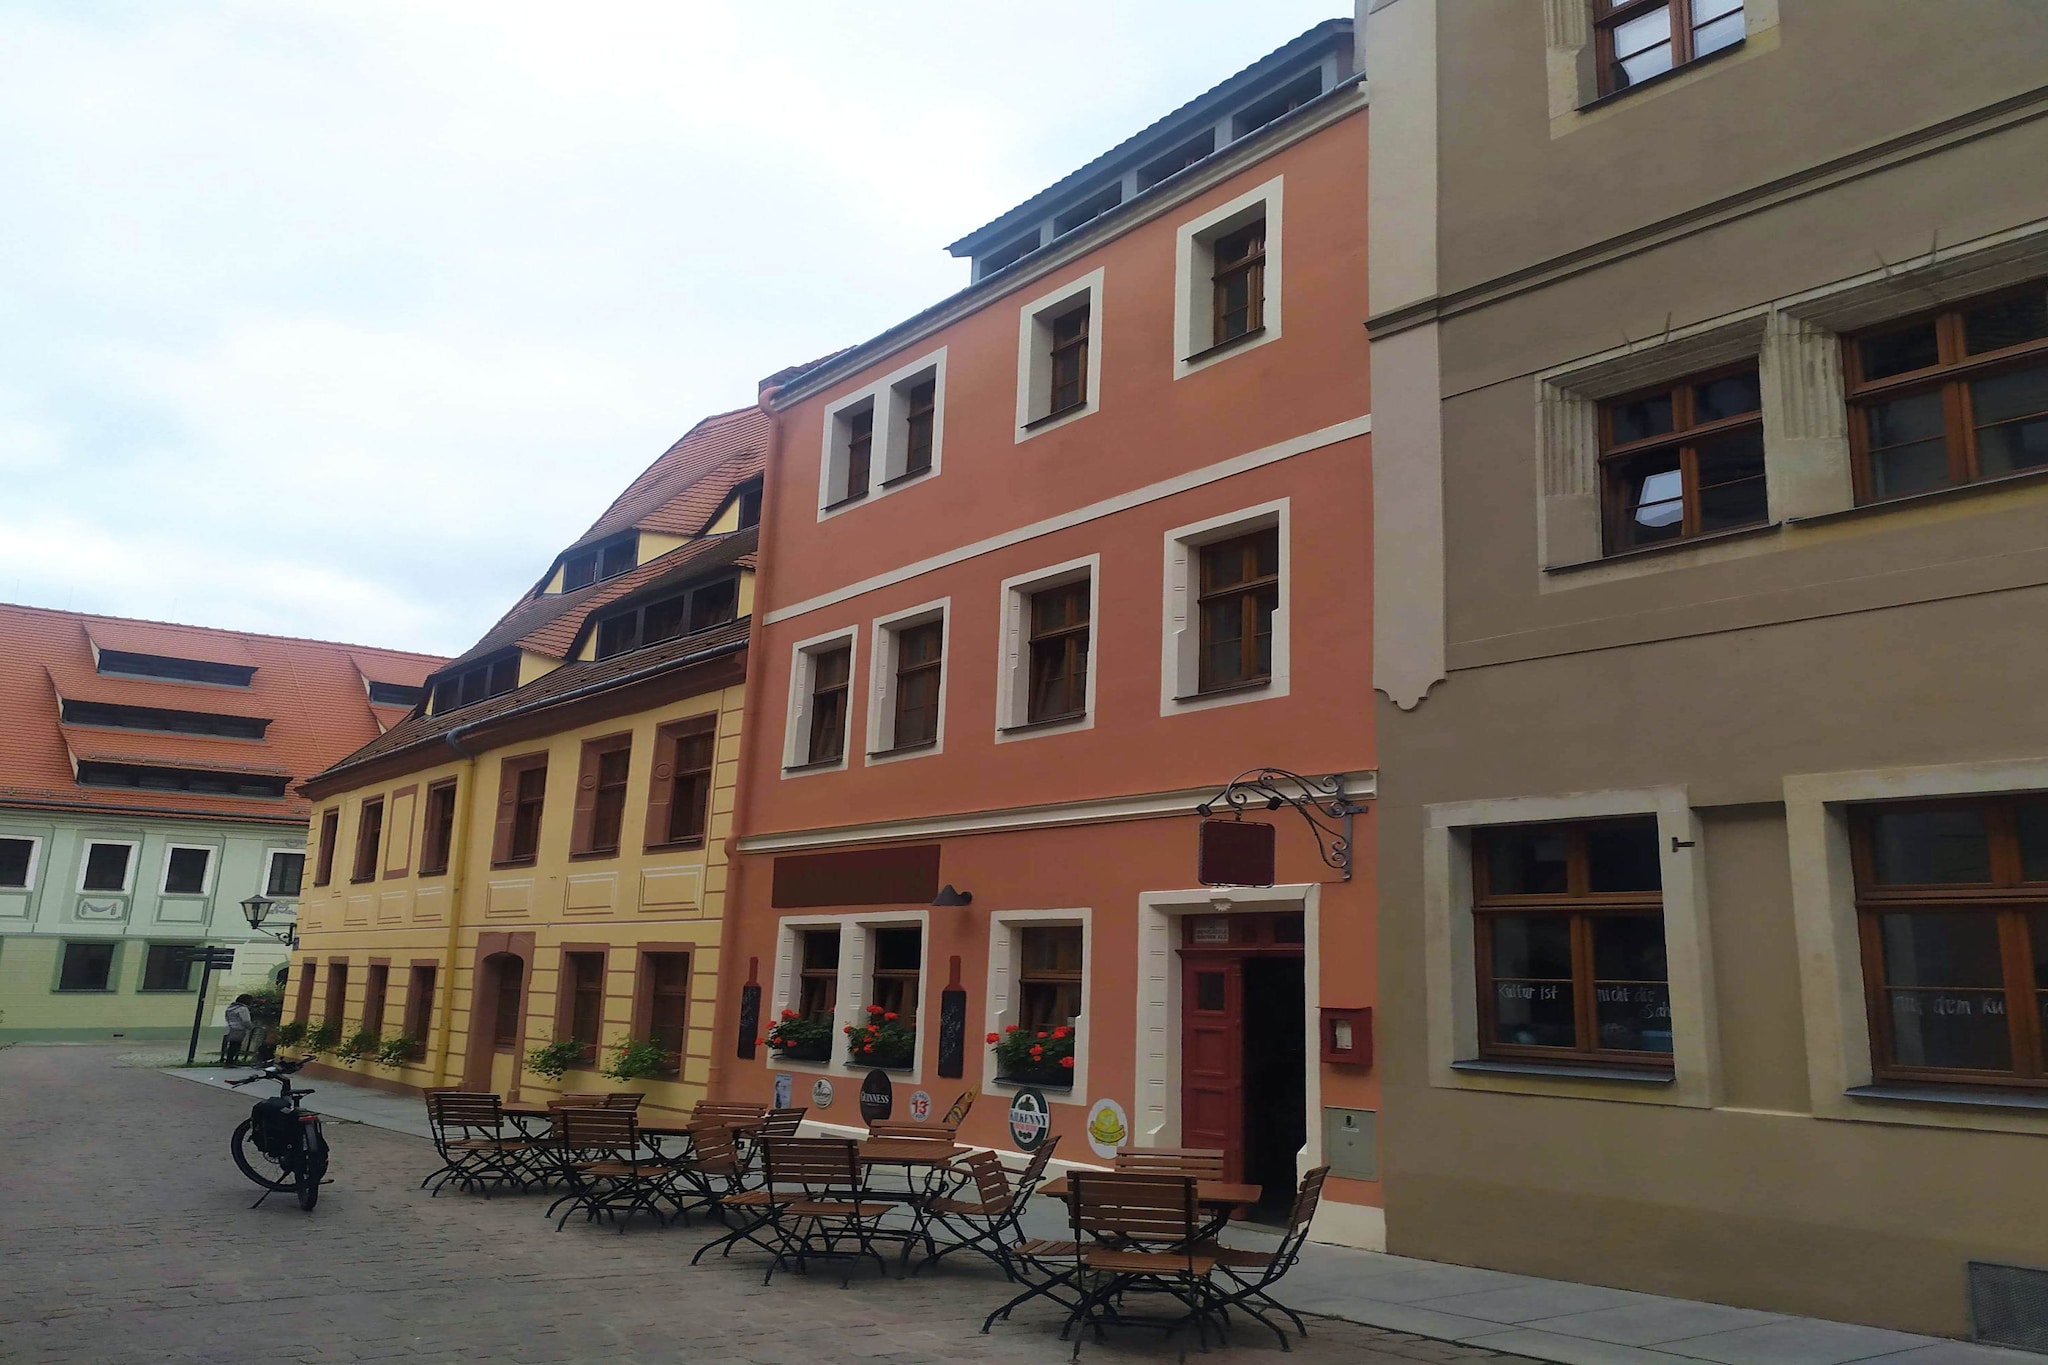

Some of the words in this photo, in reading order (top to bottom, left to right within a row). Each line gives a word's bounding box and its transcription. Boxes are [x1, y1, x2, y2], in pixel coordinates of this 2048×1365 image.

[1499, 983, 1535, 1000] Kultur
[1540, 984, 1559, 1000] ist
[1597, 985, 1630, 1002] nicht
[1933, 995, 1971, 1015] dem
[860, 1090, 890, 1104] GUINNESS
[912, 1100, 929, 1114] 13
